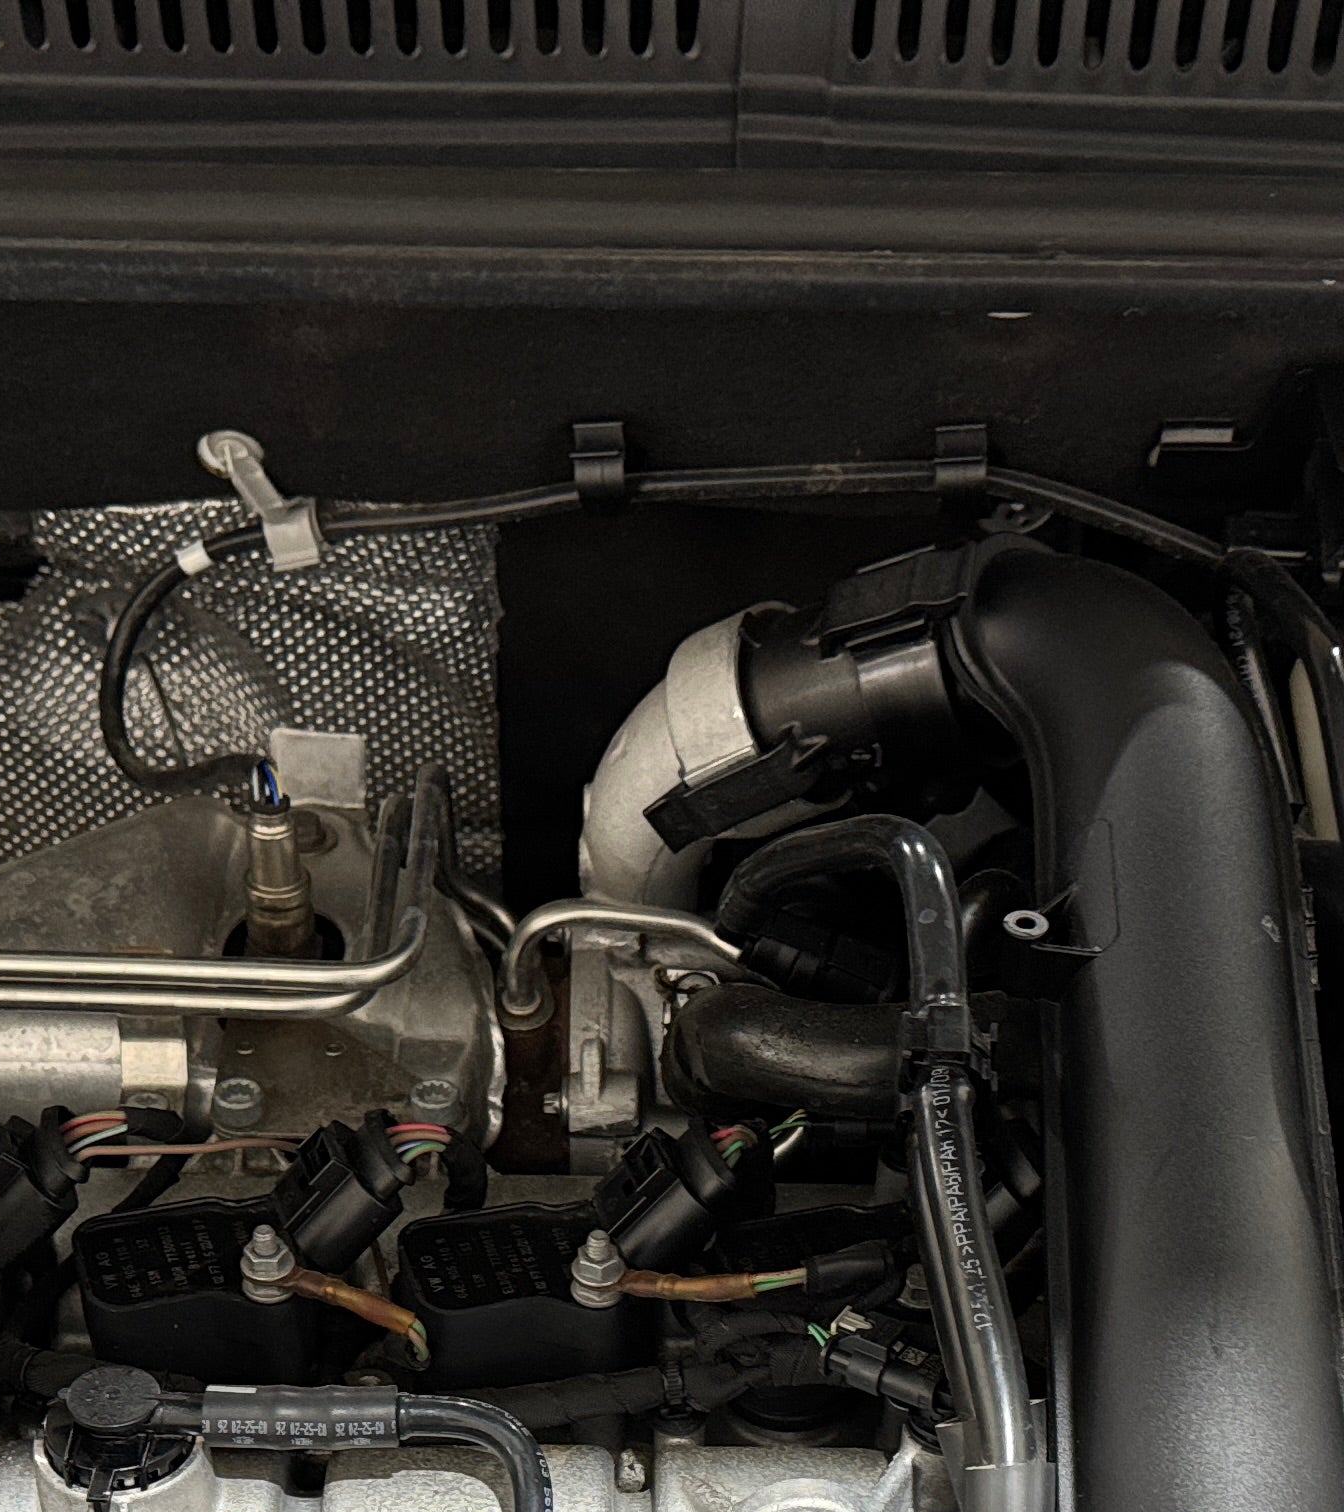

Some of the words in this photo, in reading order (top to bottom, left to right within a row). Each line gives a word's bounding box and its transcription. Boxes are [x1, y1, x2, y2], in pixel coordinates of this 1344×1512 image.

[95, 1250, 111, 1266] AG
[419, 1254, 437, 1269] AG
[427, 1277, 445, 1291] VW
